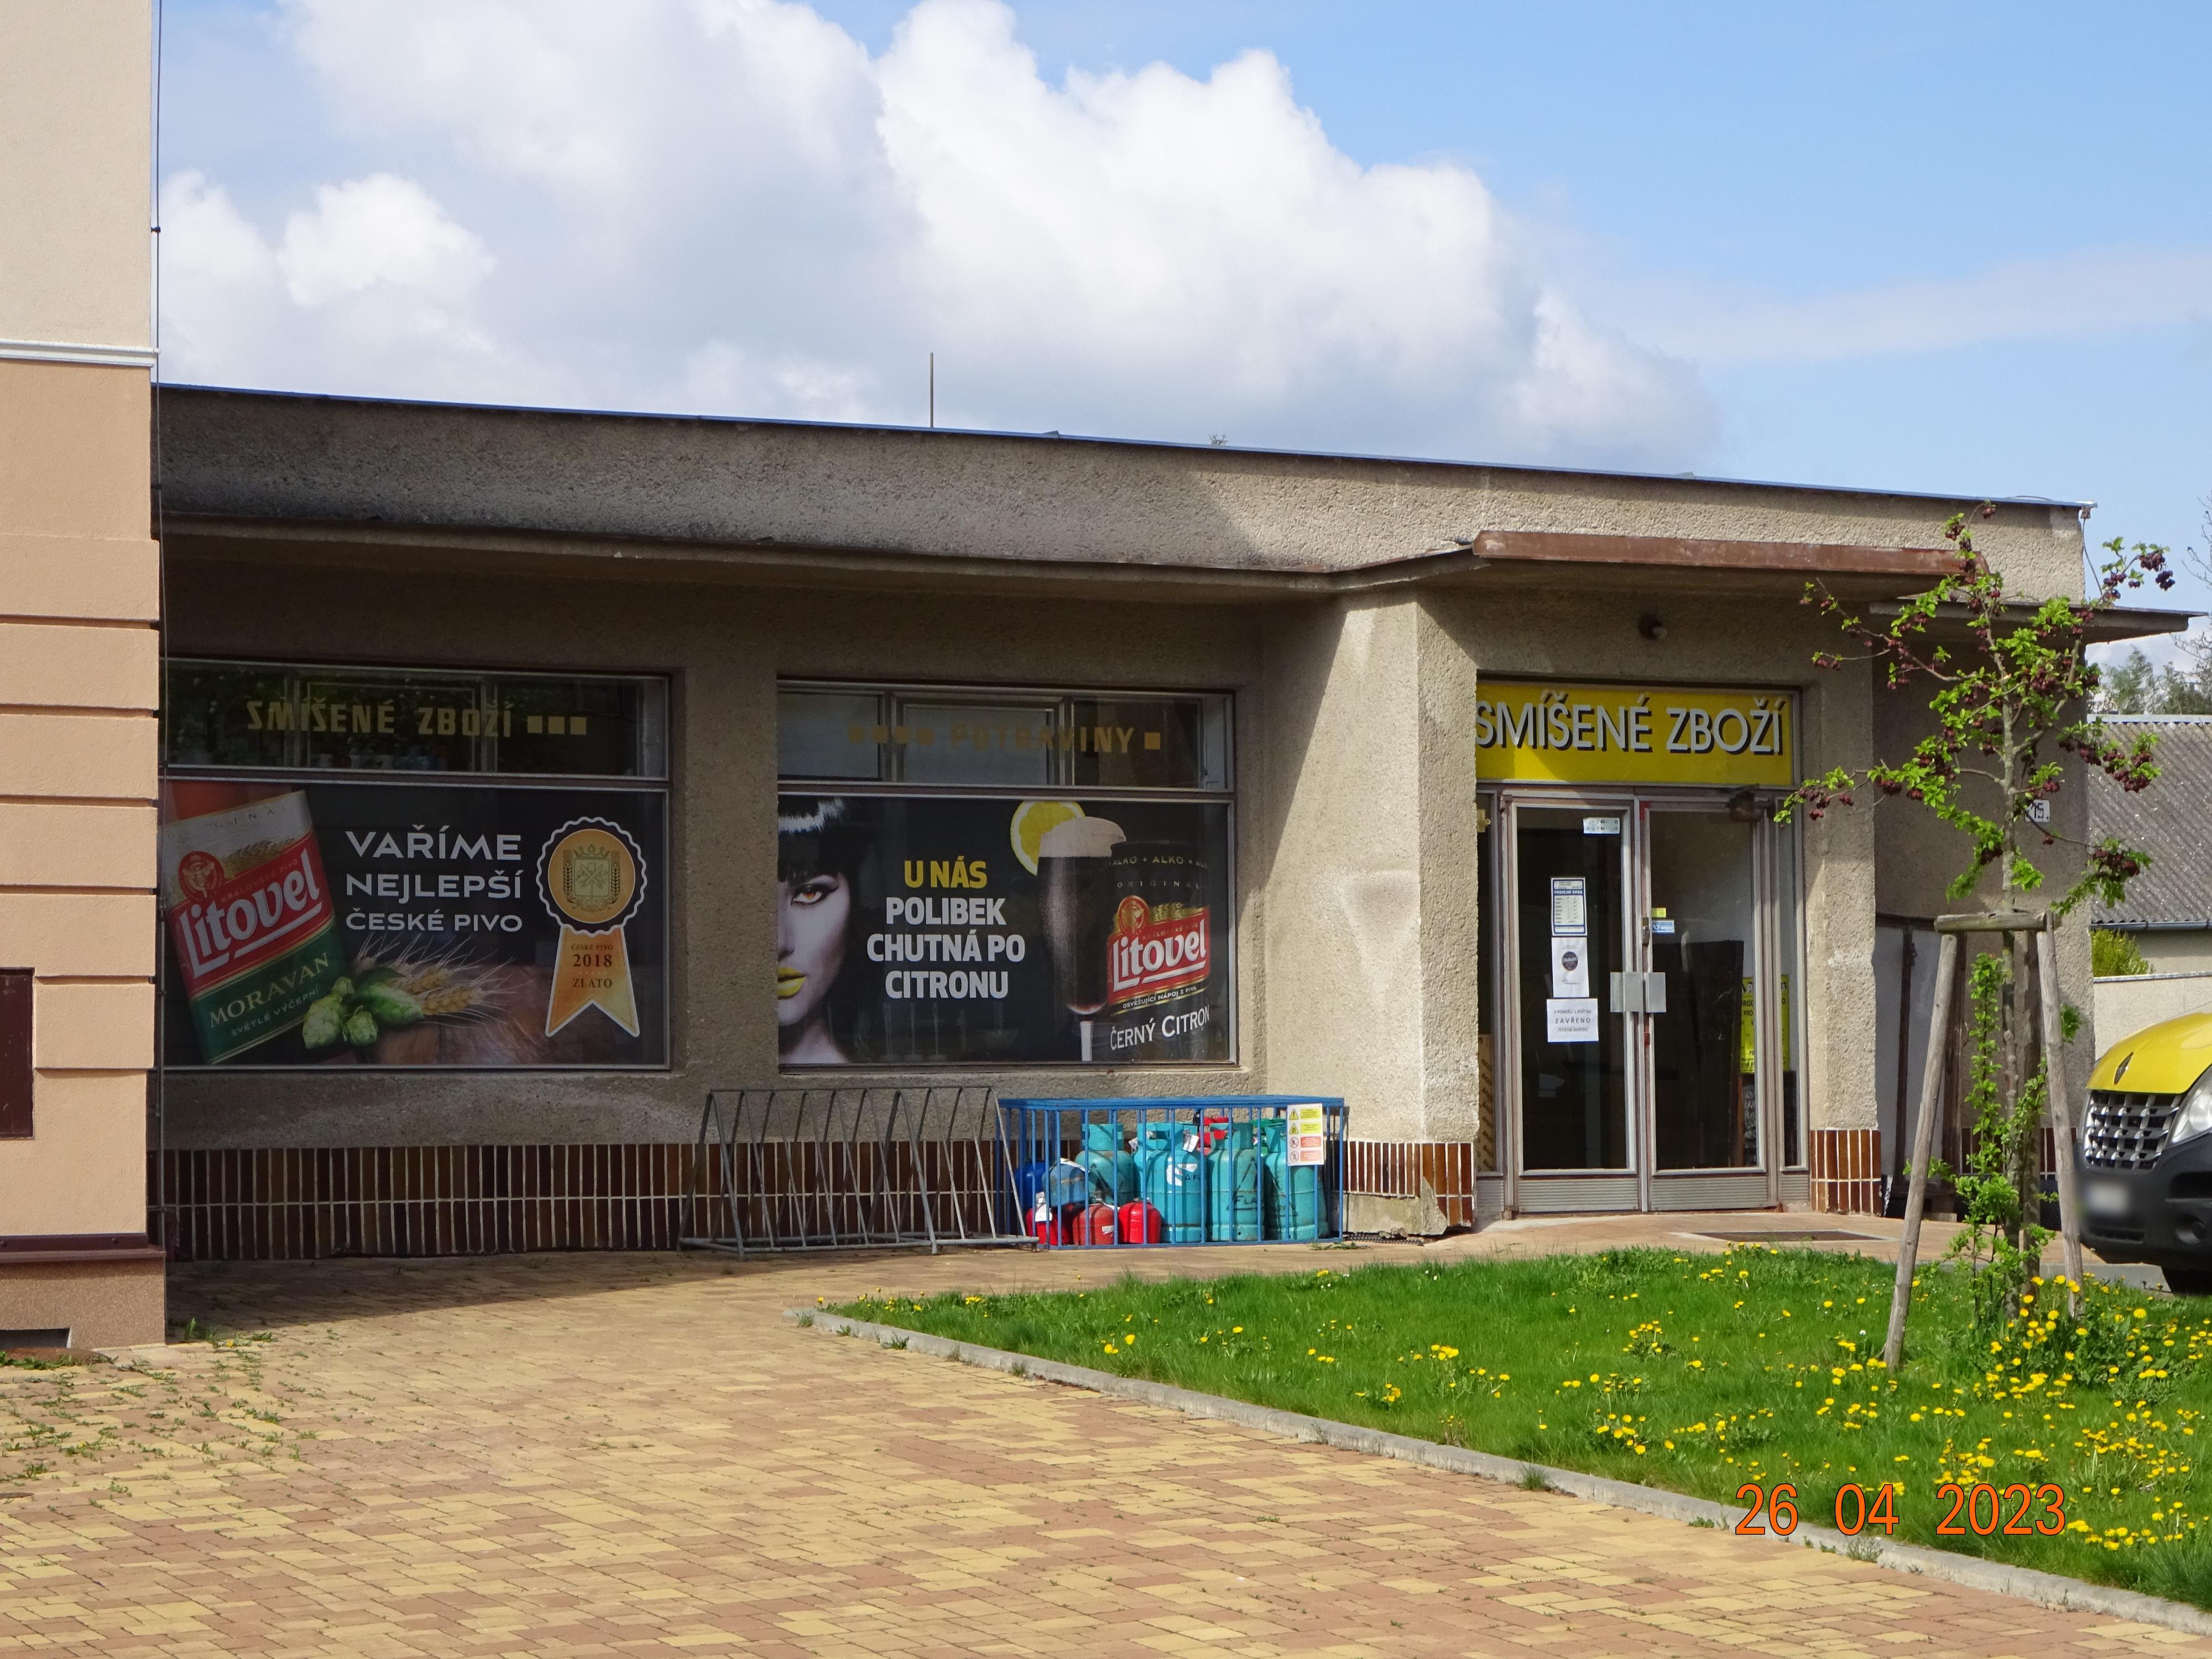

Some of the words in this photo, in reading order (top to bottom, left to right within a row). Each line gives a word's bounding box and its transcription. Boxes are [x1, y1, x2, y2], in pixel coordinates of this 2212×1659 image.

[247, 697, 395, 734] SMÍŠENÉ
[418, 700, 513, 738] ZBOŽÍ
[1476, 690, 1652, 752] SMÍŠENÉ
[1666, 696, 1786, 754] ZBOŽÍ
[950, 725, 1134, 754] POTRAVINY
[345, 825, 521, 860] VAŘÍME
[904, 860, 924, 888] U
[930, 855, 987, 889] NÁS
[1152, 856, 1183, 864] ALKO
[346, 870, 524, 904] NEJLEPŠÍ
[179, 848, 320, 979] Litovel
[346, 908, 444, 931] ČESKÉ
[454, 915, 523, 932] PIVO
[886, 897, 1007, 925] POLIBEK
[573, 954, 612, 967] 2018
[867, 929, 982, 962] CHUTNÁ
[988, 934, 1025, 962] PO
[1113, 919, 1207, 992] Litovel
[209, 952, 329, 1029] MORAVAN
[573, 978, 612, 988] ZLATO
[885, 971, 1008, 999] CITRONU
[1123, 994, 1156, 1009] OSVĚŽUJÍCÍ
[1158, 990, 1179, 1000] NÁPOJ
[1110, 1018, 1156, 1051] ČERNÝ
[1162, 1004, 1210, 1039] CITRON
